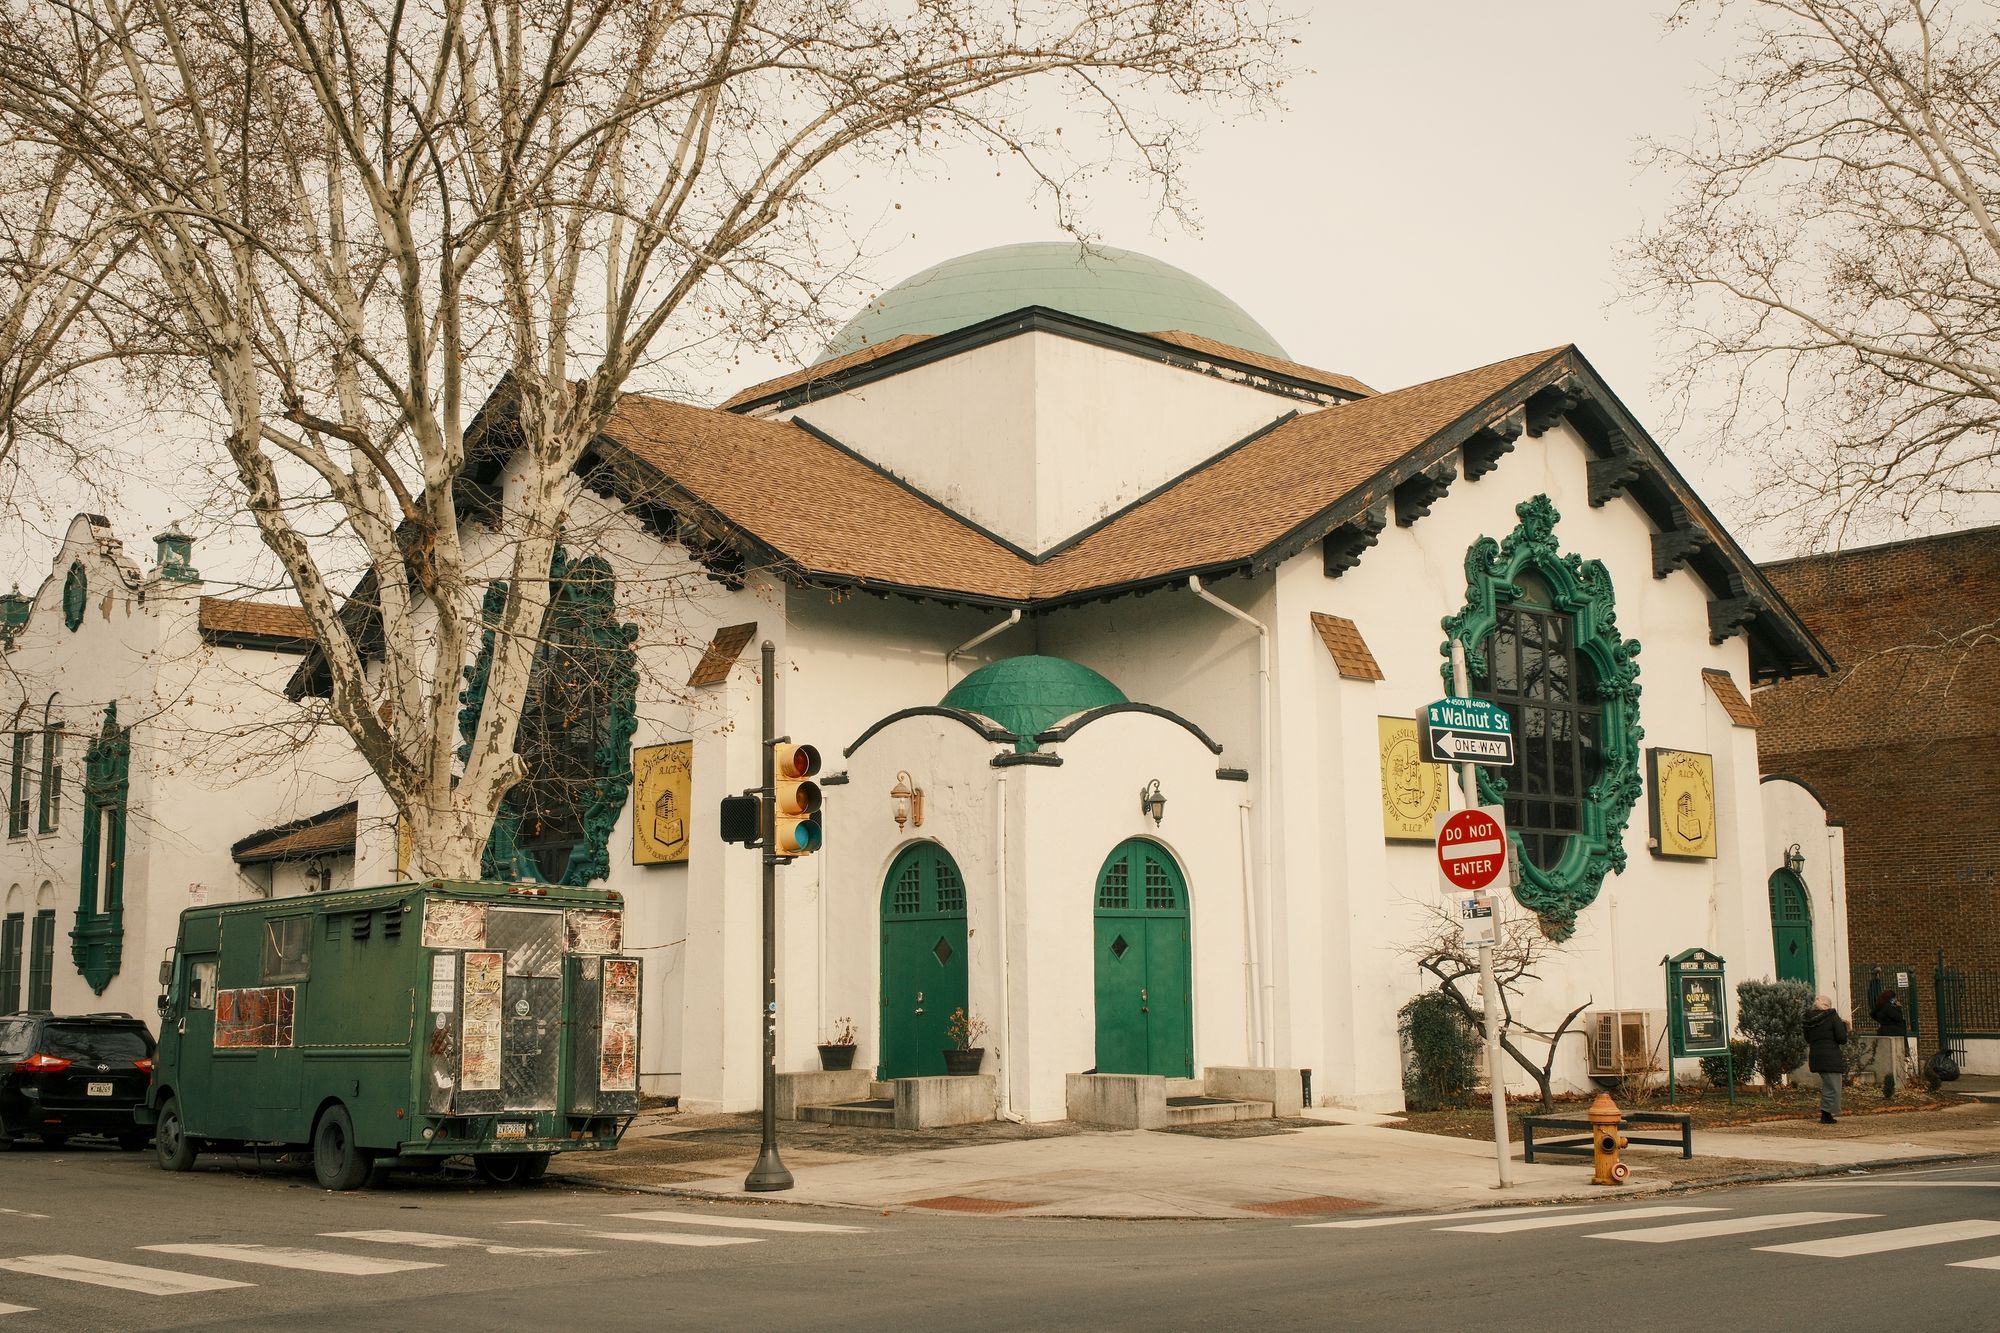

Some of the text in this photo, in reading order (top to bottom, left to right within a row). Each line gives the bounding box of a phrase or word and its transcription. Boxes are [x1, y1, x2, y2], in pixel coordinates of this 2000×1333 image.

[1465, 699, 1472, 709] W
[1441, 707, 1509, 731] Walnut St
[1454, 739, 1502, 754] ONE WAY
[1446, 823, 1493, 841] DO NOT
[1453, 859, 1492, 876] ENTER
[1463, 910, 1473, 919] 21
[1686, 994, 1710, 1004] QUR'AN
